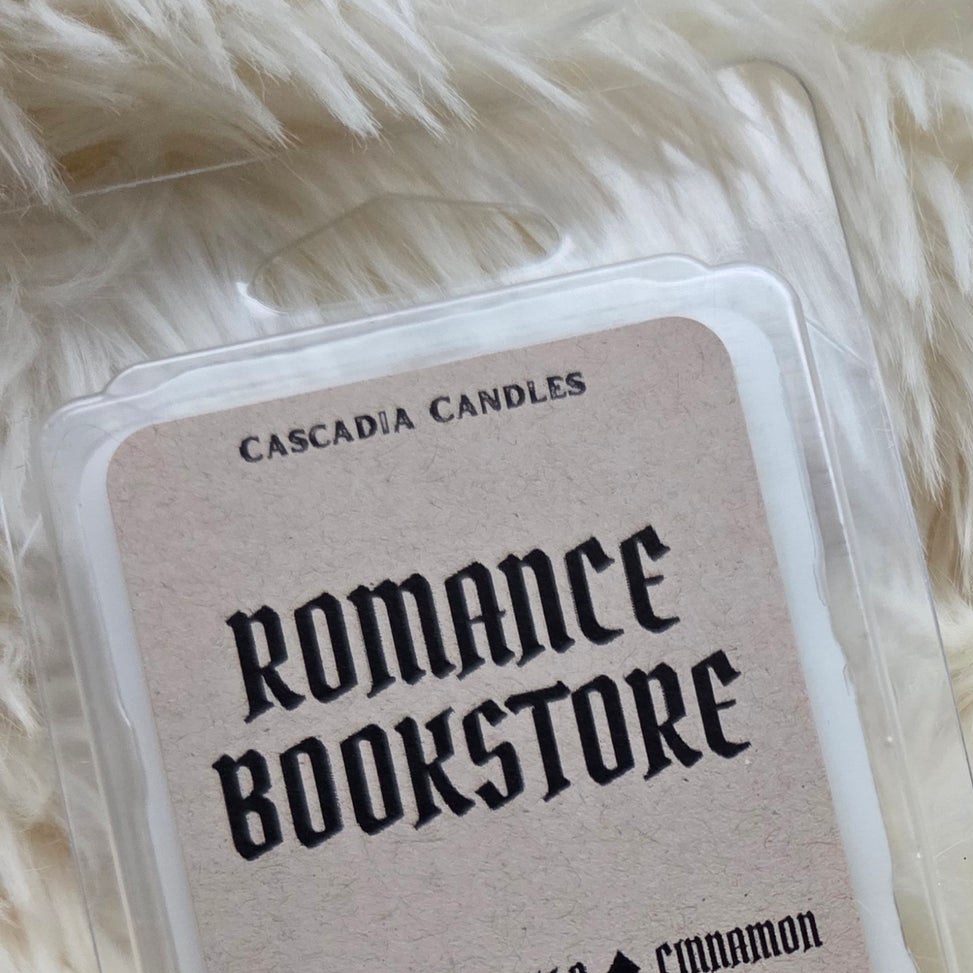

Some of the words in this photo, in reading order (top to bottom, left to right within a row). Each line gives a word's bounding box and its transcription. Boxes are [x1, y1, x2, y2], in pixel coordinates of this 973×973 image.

[239, 407, 415, 463] CASCADIA
[429, 371, 587, 423] CANDLES
[225, 524, 680, 724] ROMANCE
[212, 649, 751, 861] BOOKSTORE
